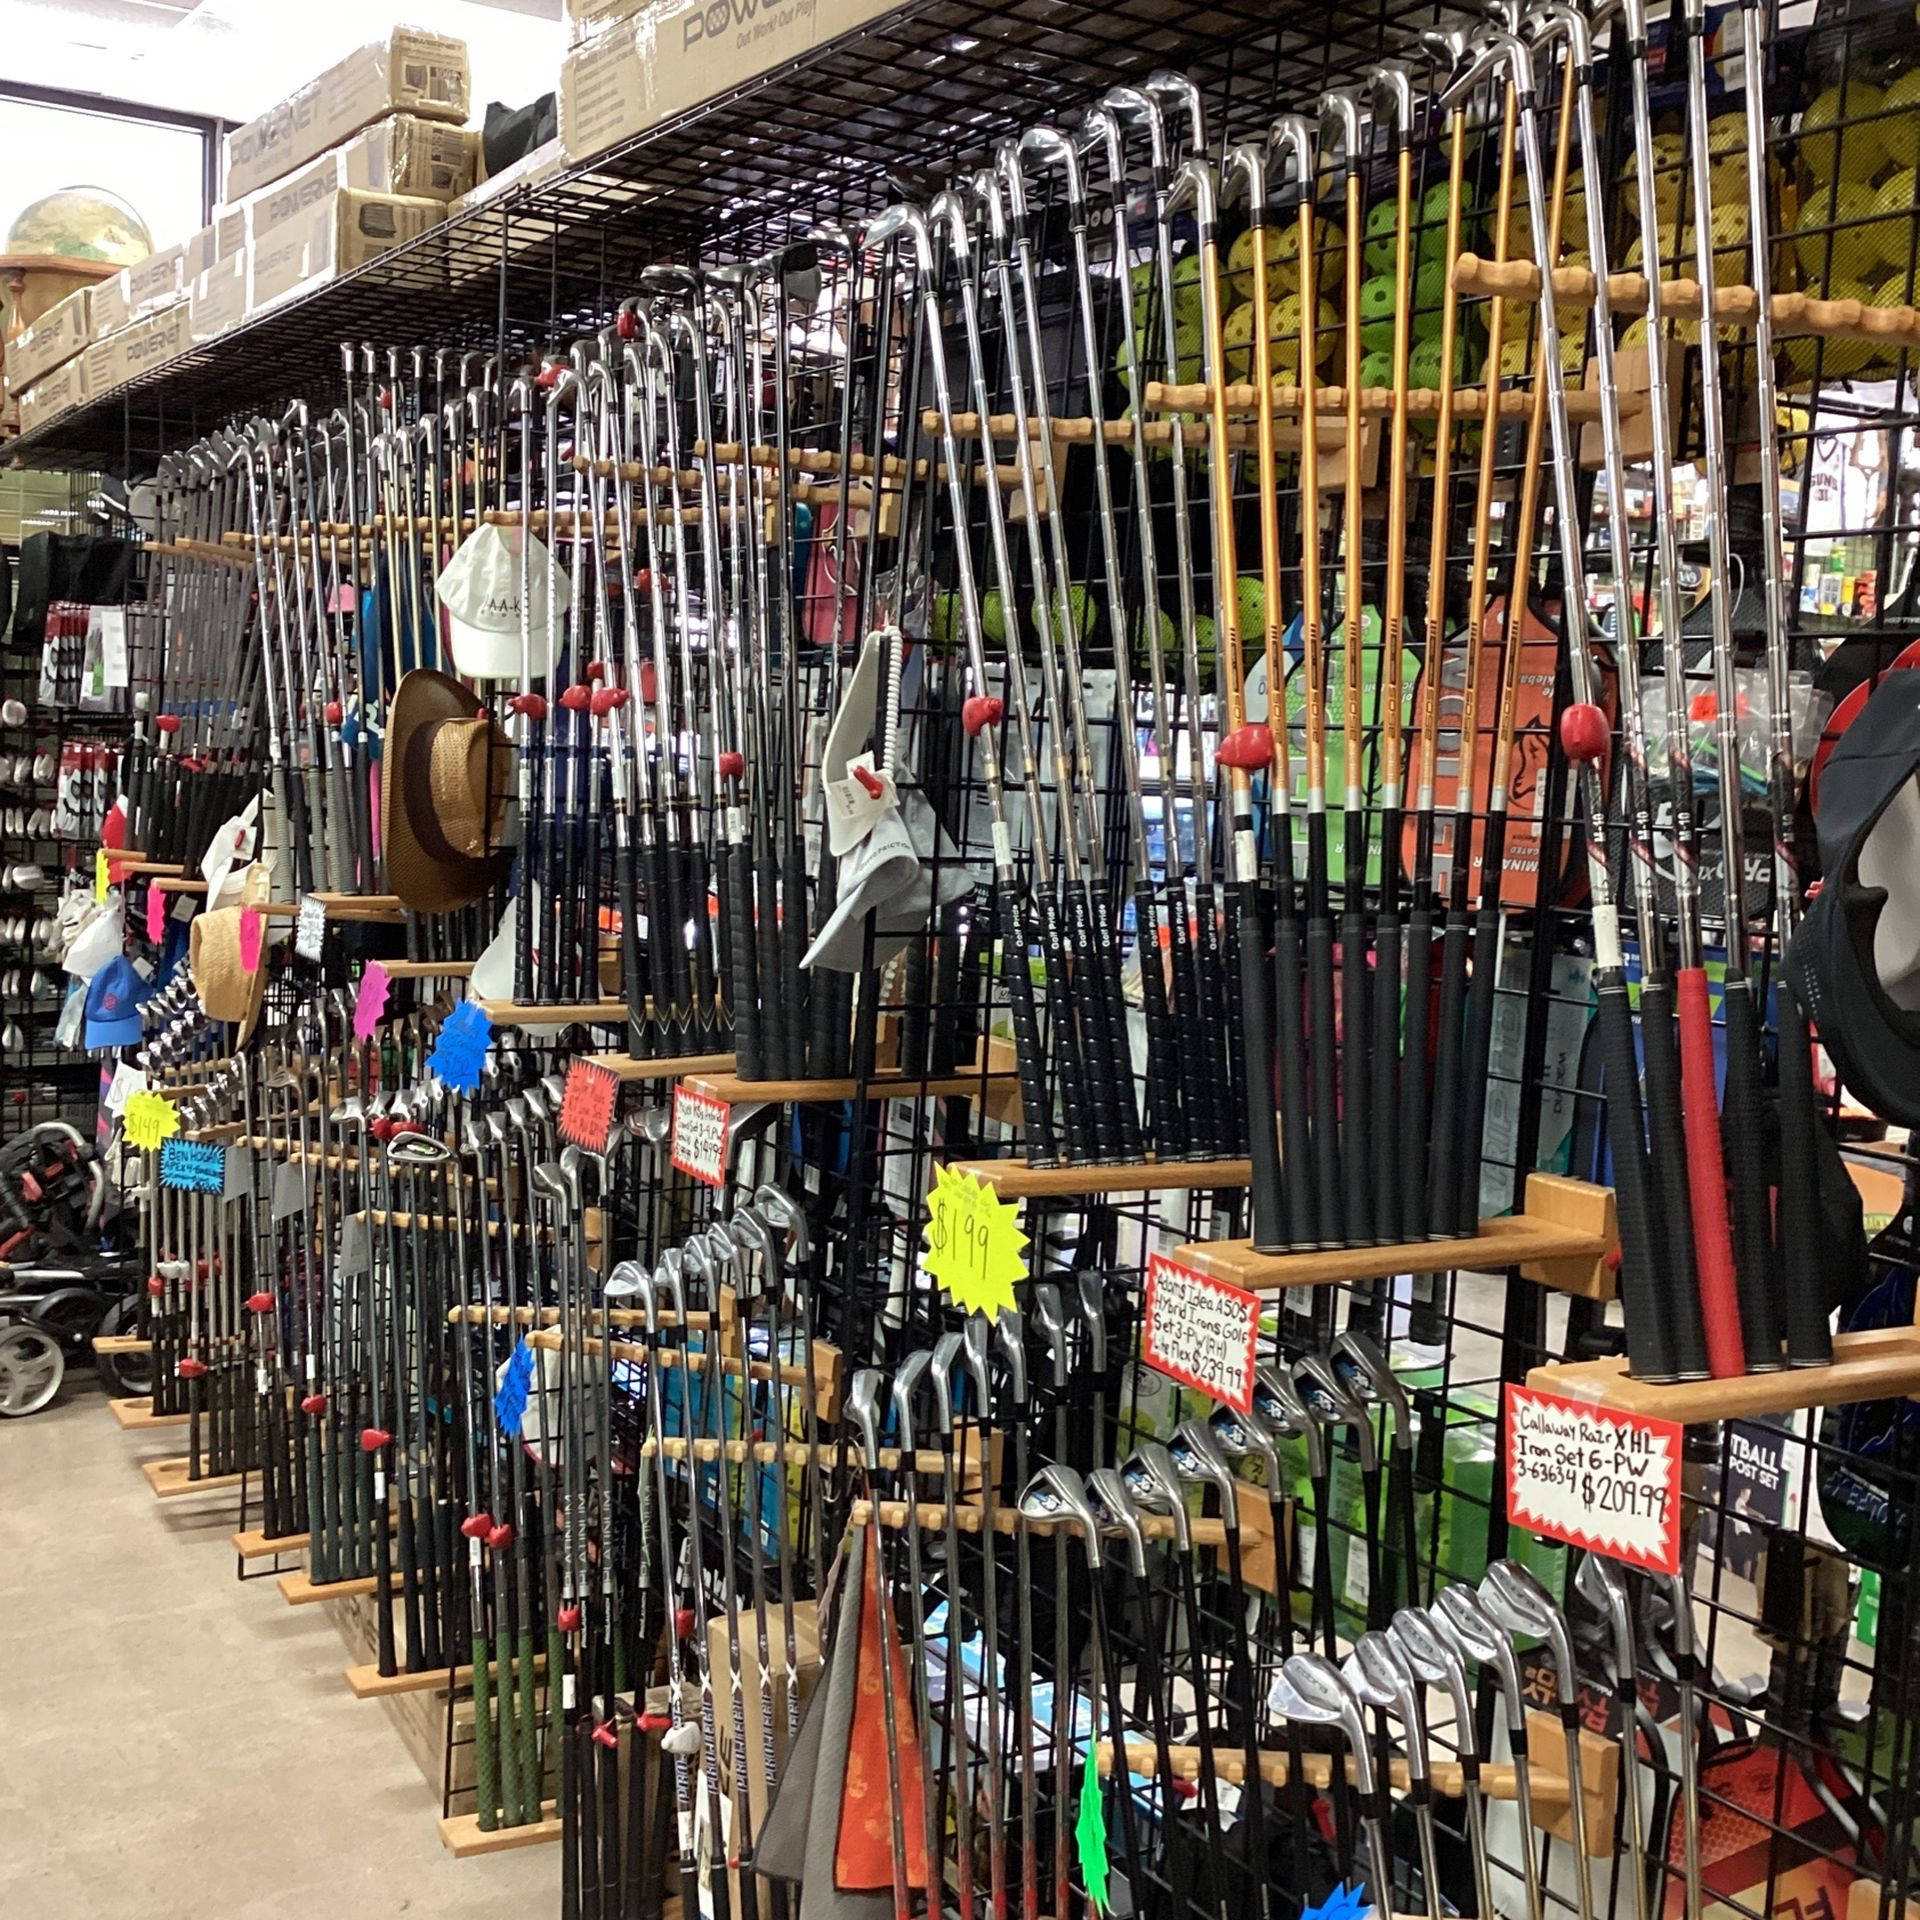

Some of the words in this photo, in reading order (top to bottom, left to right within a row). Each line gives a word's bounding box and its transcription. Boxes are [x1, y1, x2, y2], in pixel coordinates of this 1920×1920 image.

[735, 32, 750, 50] Out
[752, 14, 776, 40] Work!
[269, 165, 338, 223] POWERNE
[125, 322, 181, 363] POWERNET
[1012, 904, 1021, 928] Pride
[1047, 906, 1057, 930] Pride
[1076, 904, 1085, 928] Pride
[1098, 904, 1108, 928] Pride
[1175, 901, 1185, 925] Pride
[1207, 908, 1216, 931] Pride
[1014, 928, 1024, 948] Golf
[1049, 931, 1060, 950] Golf
[1077, 929, 1088, 948] Golf
[1100, 929, 1111, 948] Golf
[1176, 926, 1186, 945] Golf
[1208, 932, 1218, 951] Golf
[128, 1111, 161, 1143] $149
[932, 1197, 990, 1281] $199
[1157, 1273, 1187, 1300] Adams
[1187, 1284, 1214, 1311] Idea
[1187, 1306, 1222, 1335] Irons
[1222, 1322, 1249, 1344] Golf
[1171, 1340, 1192, 1363] Flex
[1191, 1349, 1243, 1390] $239.99
[1520, 1405, 1576, 1441] Callaway
[1579, 1422, 1613, 1445] Razr
[1517, 1434, 1552, 1458] Iron
[1554, 1443, 1585, 1468] Set
[1588, 1449, 1649, 1478] 6-PW
[1729, 1456, 1757, 1480] POST
[1758, 1470, 1780, 1491] SET
[1517, 1458, 1577, 1494] 3-63634
[1581, 1471, 1668, 1524] $209.99
[702, 1700, 719, 1796] PROJECT
[732, 1699, 749, 1793] PROJECT
